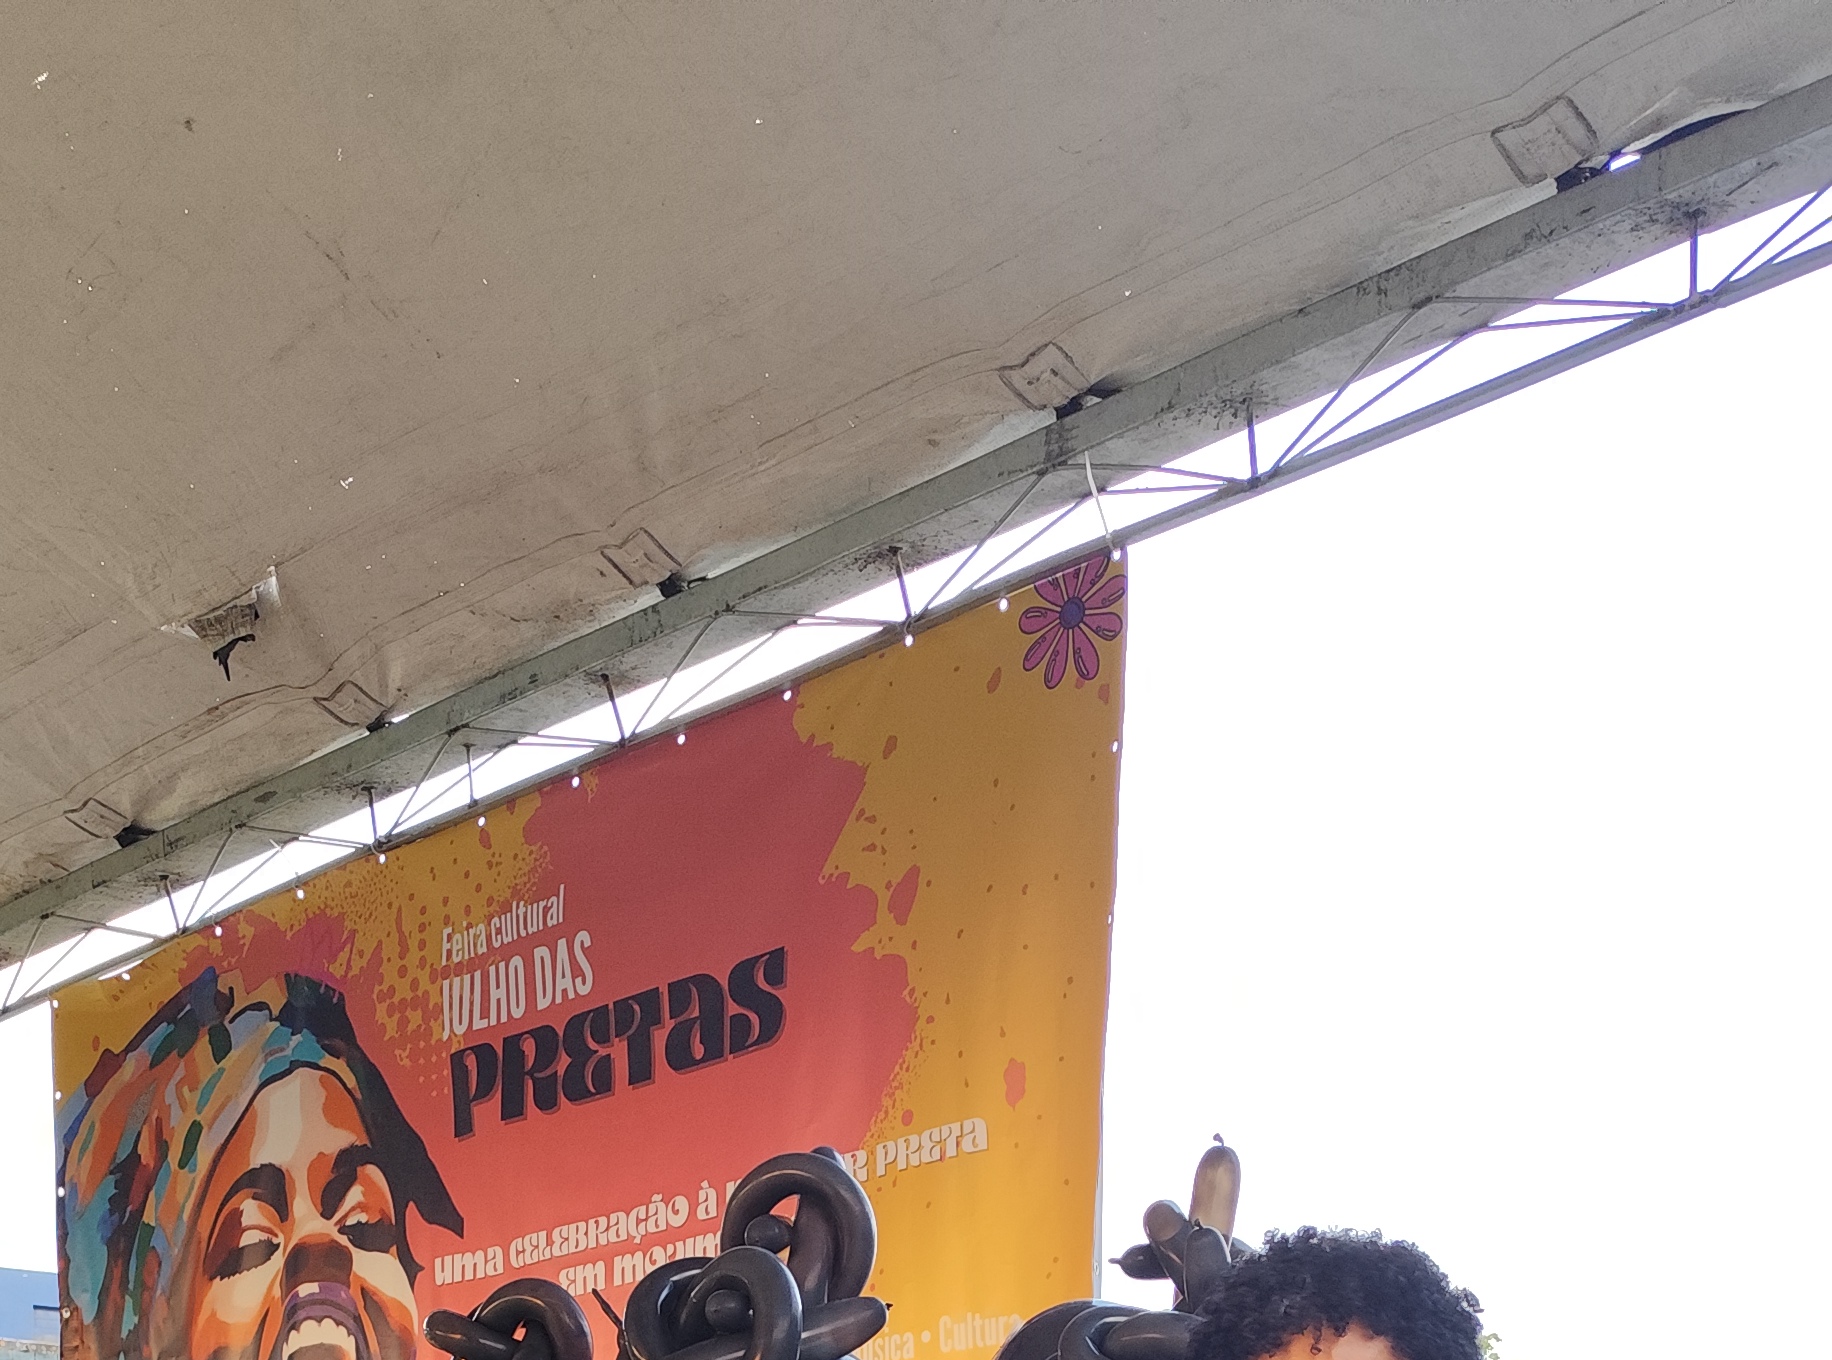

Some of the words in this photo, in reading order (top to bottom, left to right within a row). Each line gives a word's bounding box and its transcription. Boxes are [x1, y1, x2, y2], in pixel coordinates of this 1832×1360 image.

[442, 920, 487, 966] Feira
[490, 883, 565, 949] cultural
[442, 955, 526, 1042] JULHO
[533, 930, 594, 1011] DAS
[450, 946, 789, 1142] PRETAS
[875, 1117, 989, 1178] PRETA
